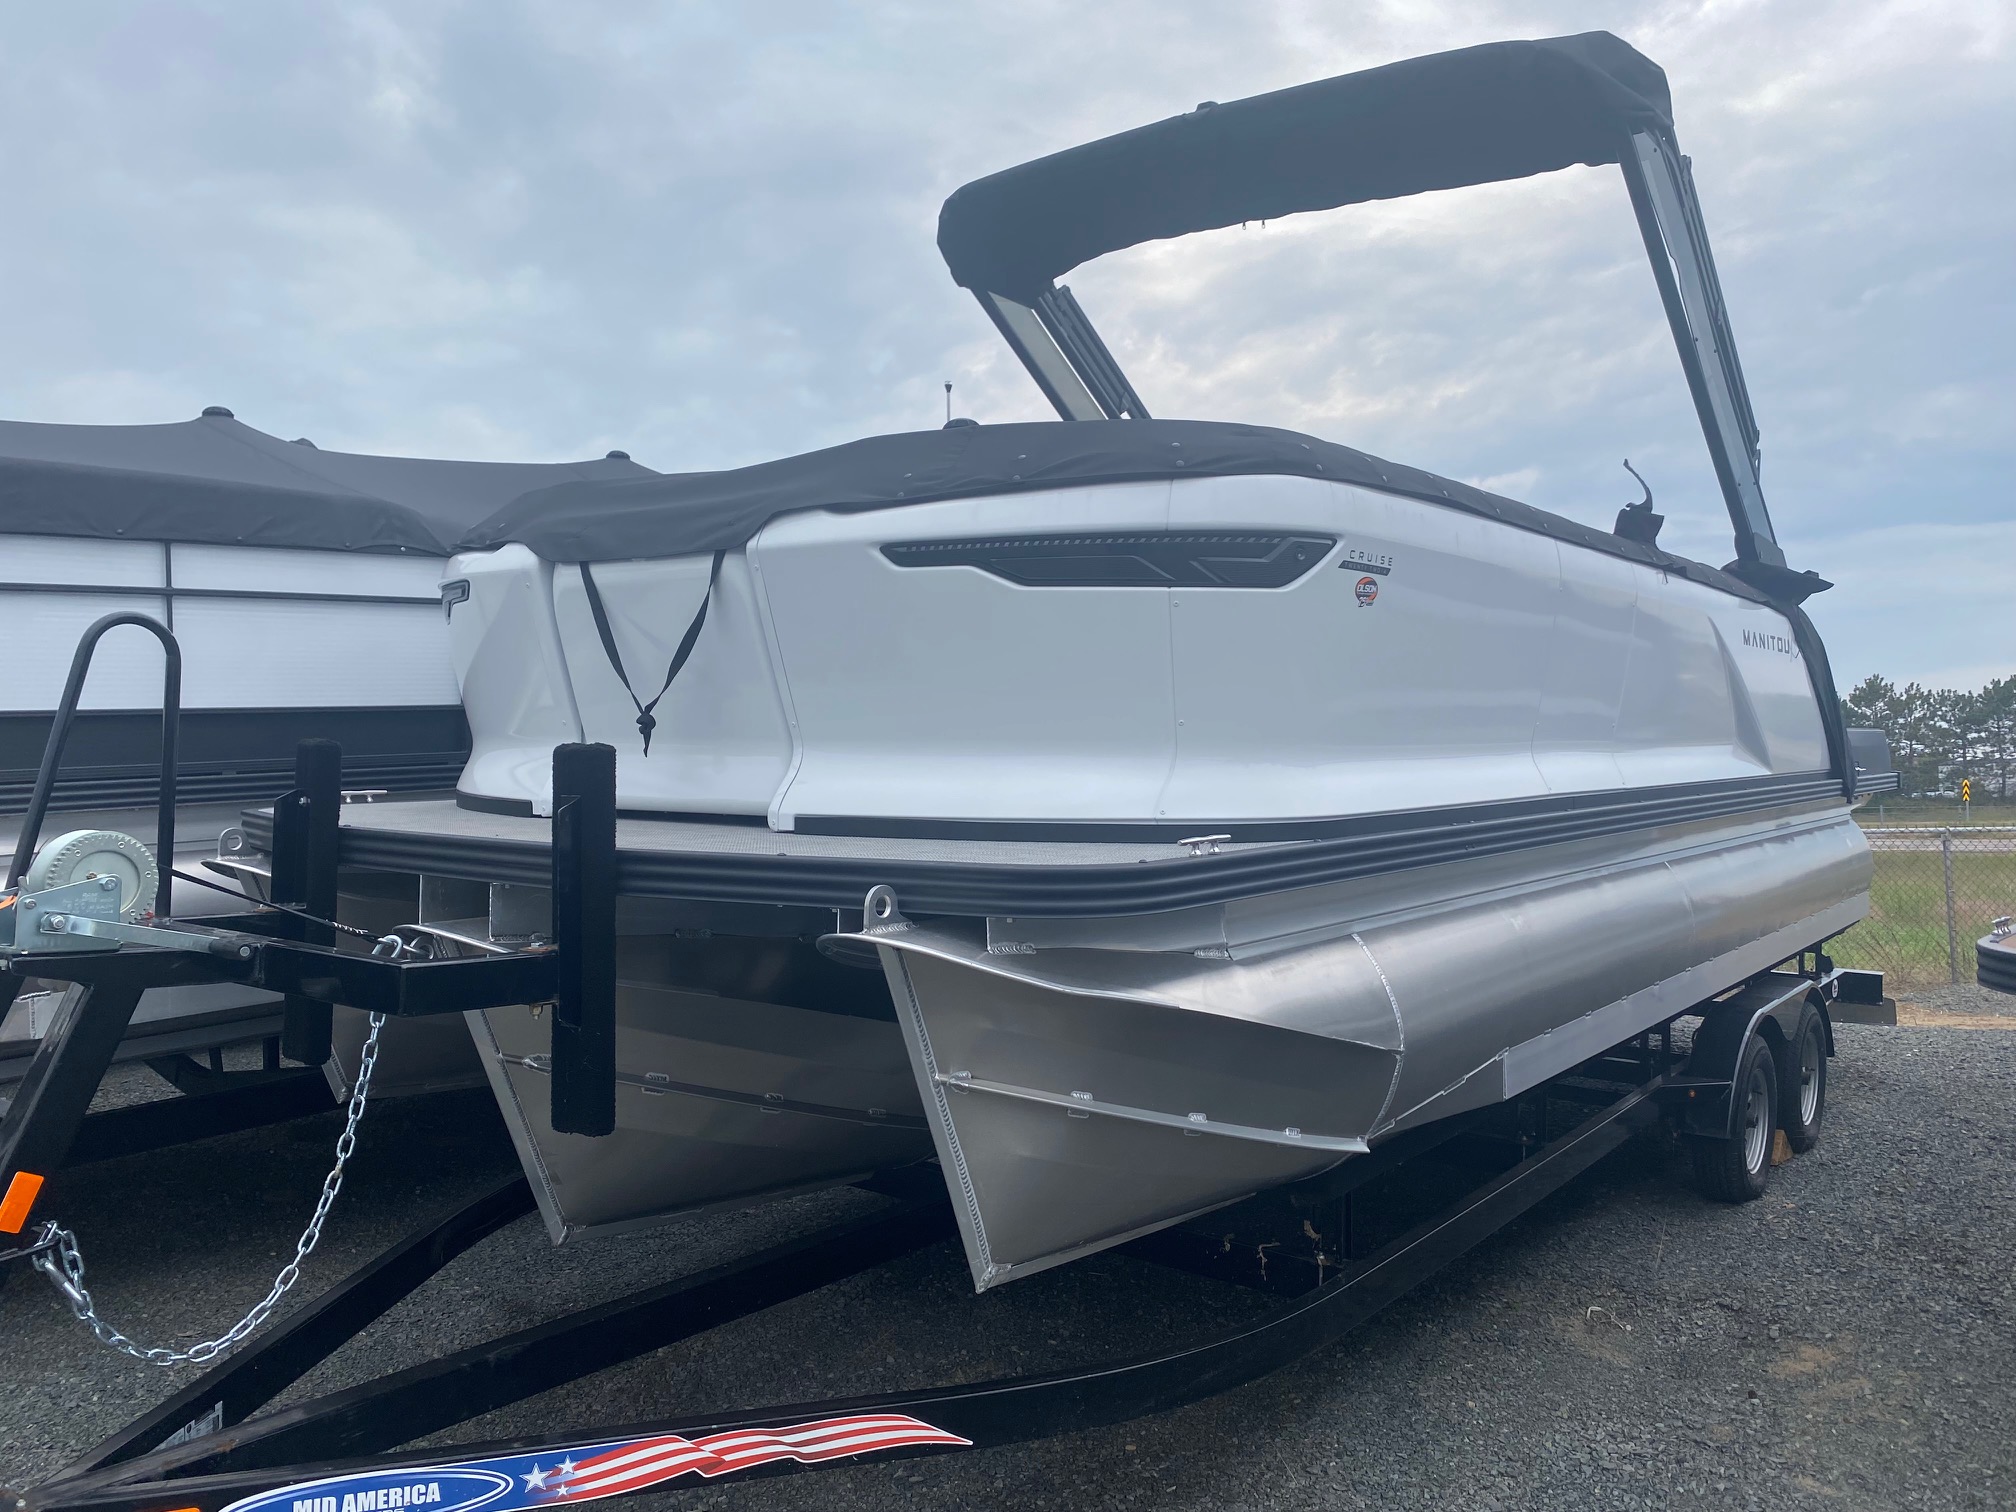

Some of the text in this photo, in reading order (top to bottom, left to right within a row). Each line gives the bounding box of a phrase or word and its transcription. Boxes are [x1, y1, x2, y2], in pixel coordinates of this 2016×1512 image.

[1349, 550, 1393, 566] CRUISE
[1742, 629, 1790, 654] MANITOU
[293, 1482, 441, 1512] MID AMERICA
